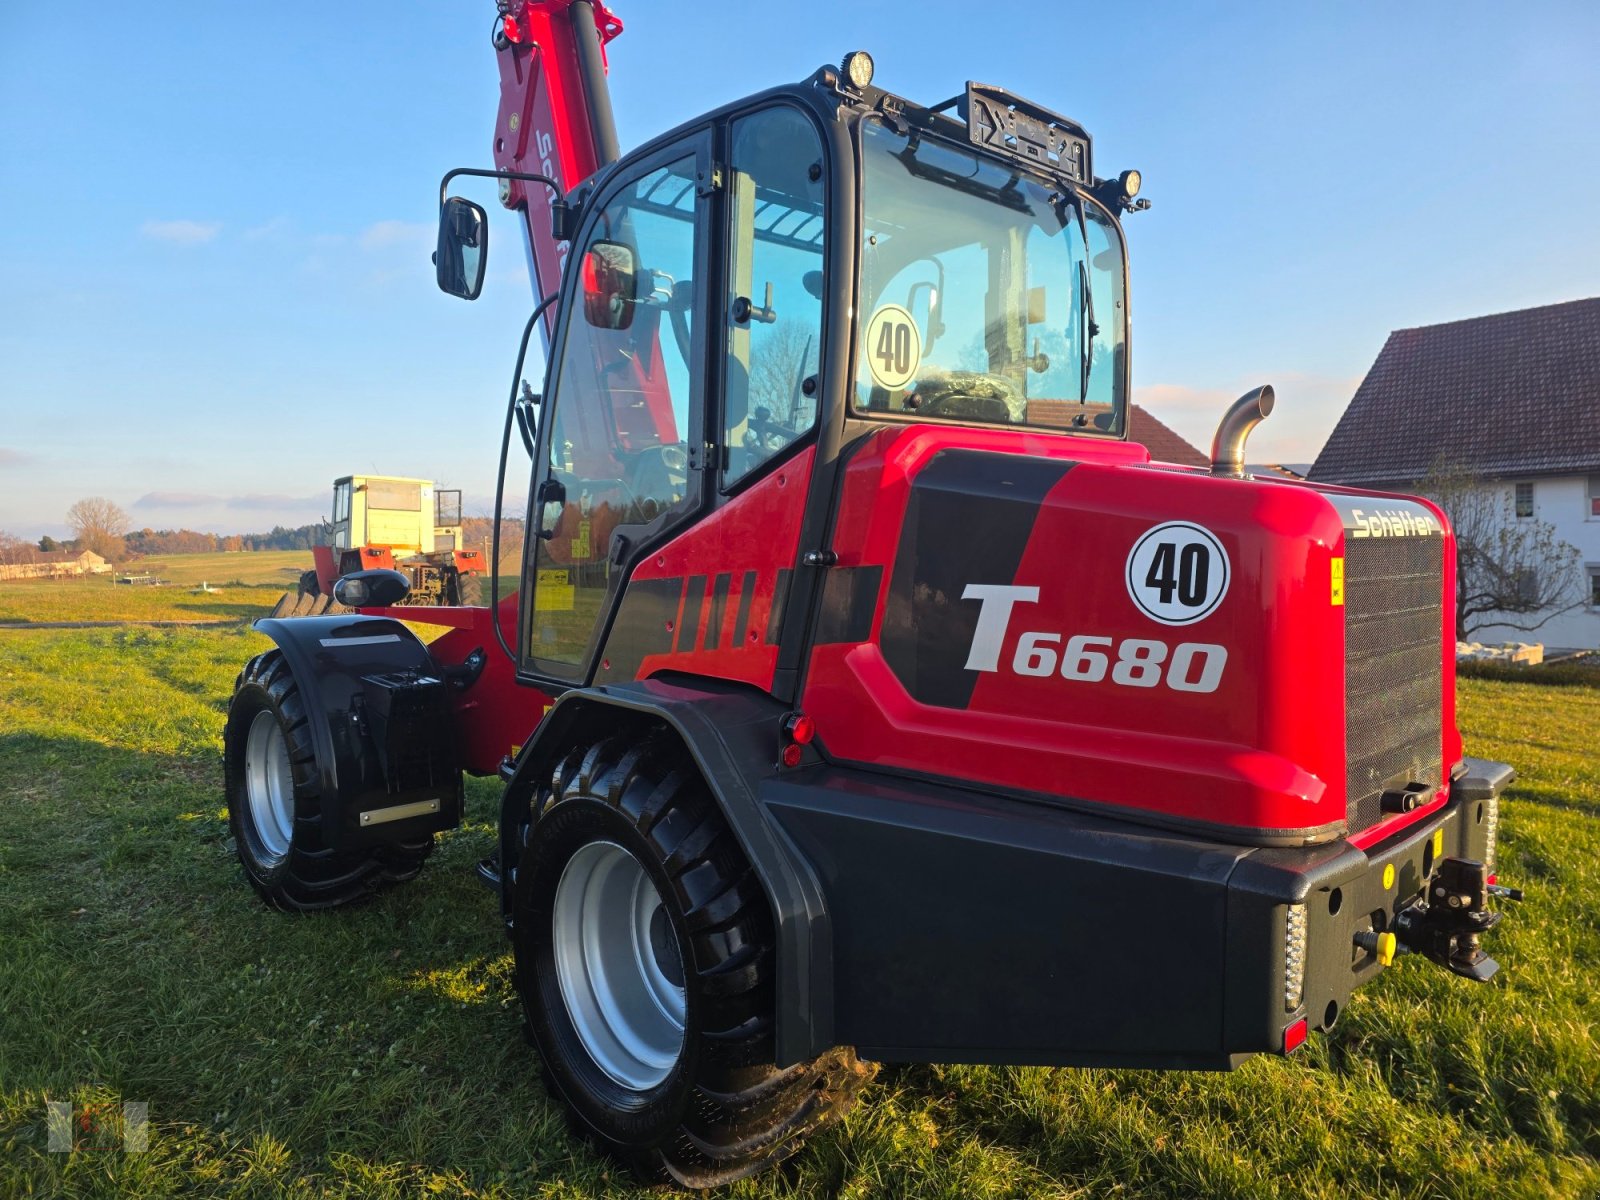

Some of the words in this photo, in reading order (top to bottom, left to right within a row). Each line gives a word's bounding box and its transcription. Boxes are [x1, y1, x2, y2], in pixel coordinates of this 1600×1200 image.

[876, 321, 911, 375] 40
[1351, 508, 1434, 538] Schäffer
[1145, 542, 1210, 608] 40
